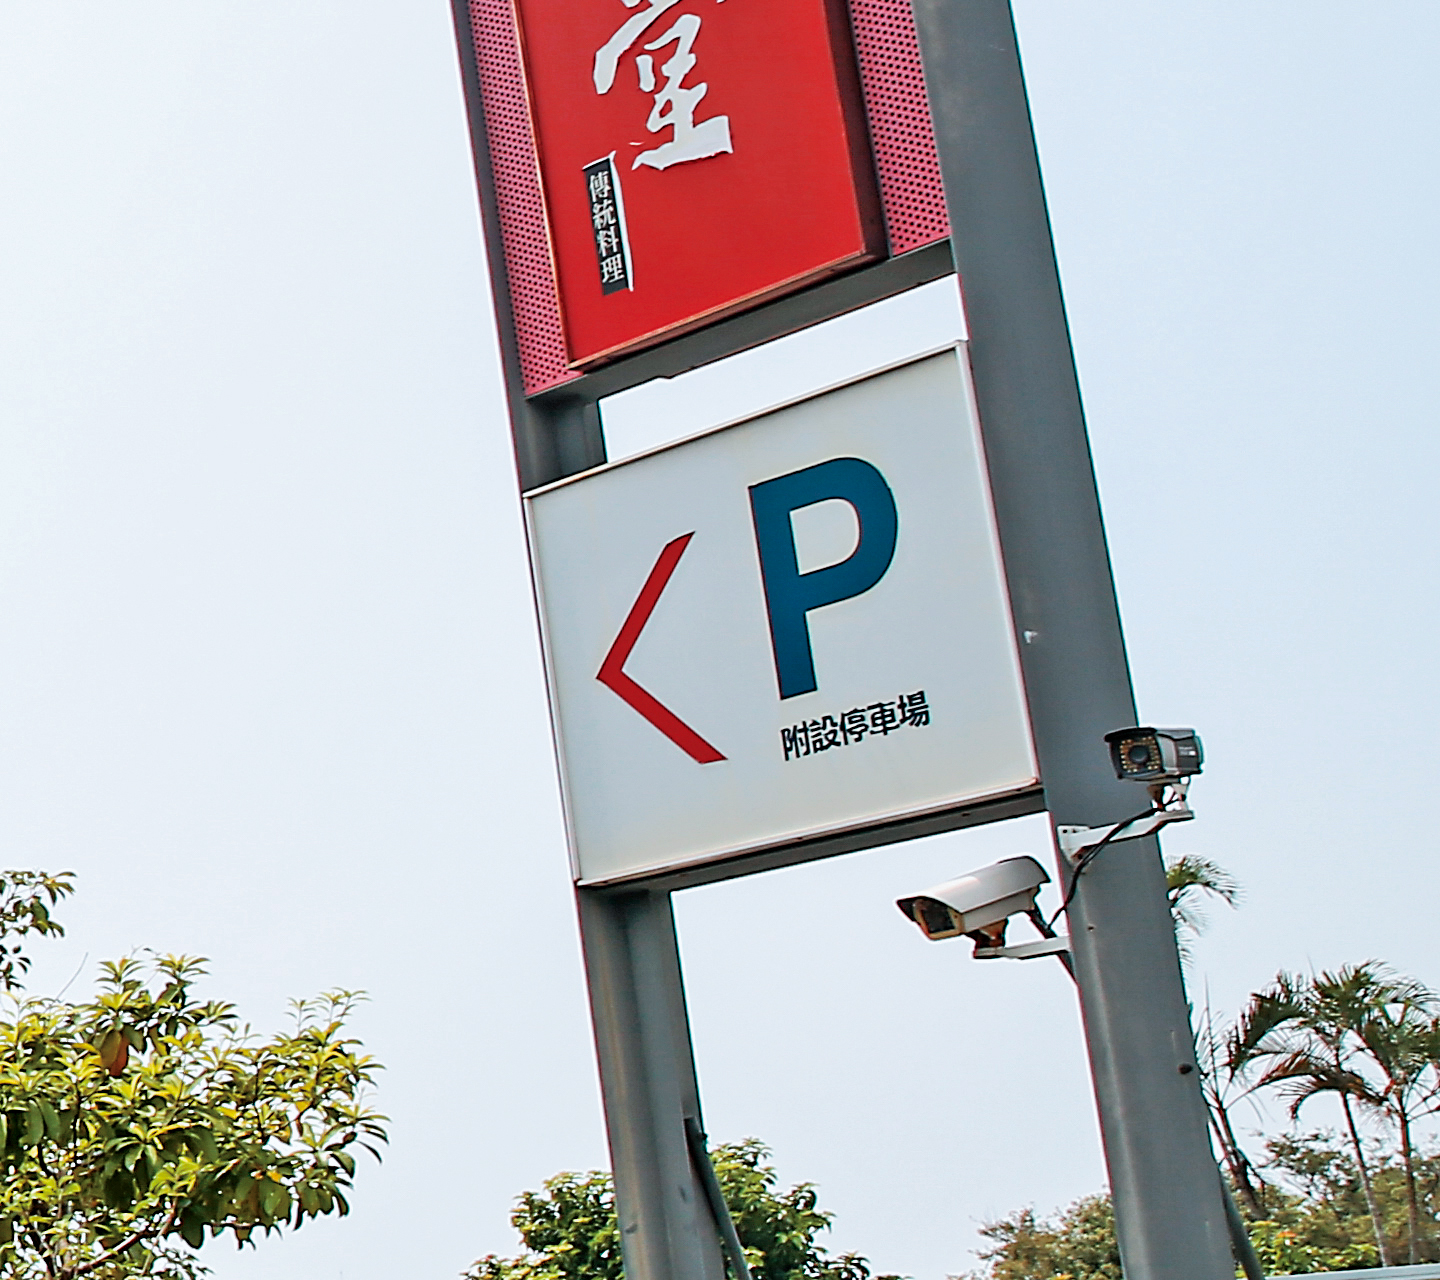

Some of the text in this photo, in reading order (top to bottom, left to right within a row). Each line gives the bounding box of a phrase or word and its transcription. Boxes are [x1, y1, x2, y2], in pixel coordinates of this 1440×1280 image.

[589, 171, 625, 283] 傳統料理
[747, 457, 899, 701] P
[780, 690, 930, 762] 附設停車場
